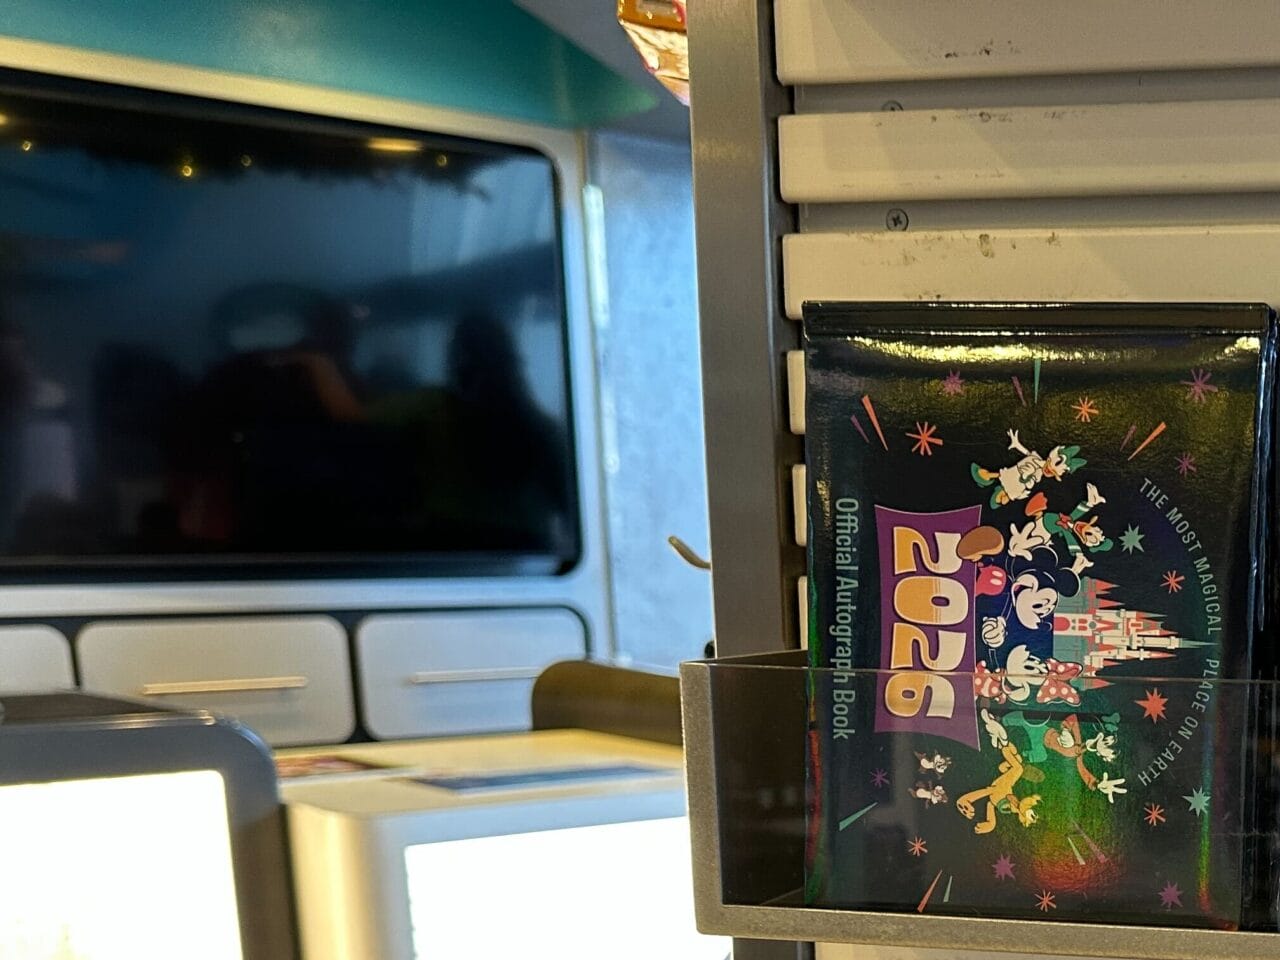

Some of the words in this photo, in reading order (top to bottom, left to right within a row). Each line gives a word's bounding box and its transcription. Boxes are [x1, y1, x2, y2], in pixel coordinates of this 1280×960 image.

[1139, 477, 1169, 510] THE
[835, 497, 860, 571] Official
[1165, 507, 1202, 552] MOST
[1193, 556, 1222, 635] MAGICAL
[829, 575, 860, 684] Autograph
[884, 526, 969, 719] 2026
[1191, 658, 1220, 713] PLACE
[833, 689, 856, 740] Book
[1177, 716, 1199, 740] ON
[1137, 740, 1183, 787] EARTH
